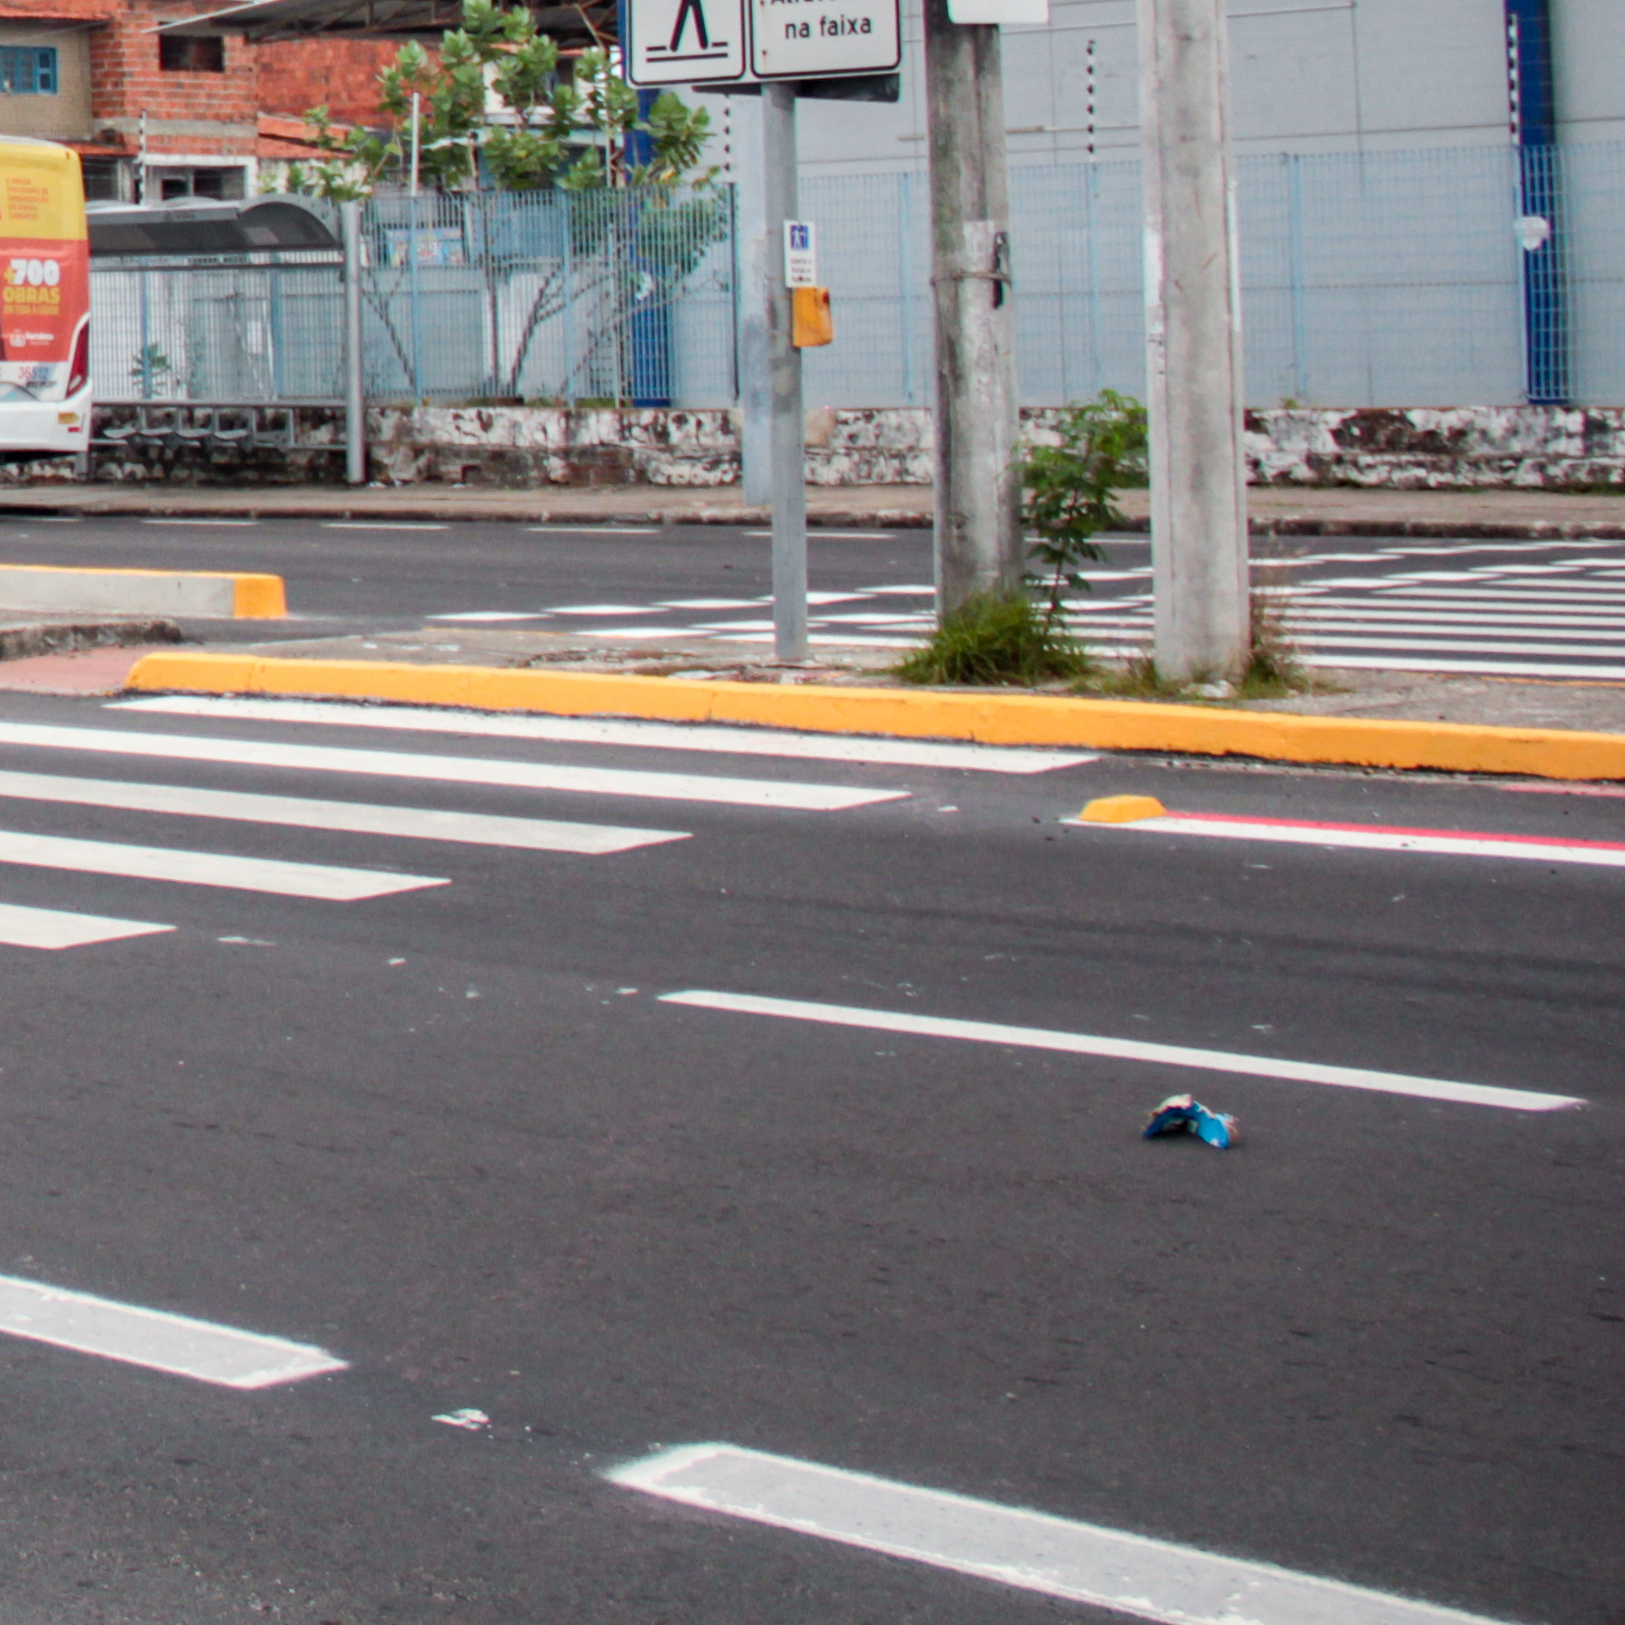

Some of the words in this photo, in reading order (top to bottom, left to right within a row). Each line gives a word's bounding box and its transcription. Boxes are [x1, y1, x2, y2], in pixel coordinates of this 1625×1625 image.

[784, 21, 810, 39] na
[819, 14, 871, 37] faixa
[2, 287, 60, 304] OBRAS
